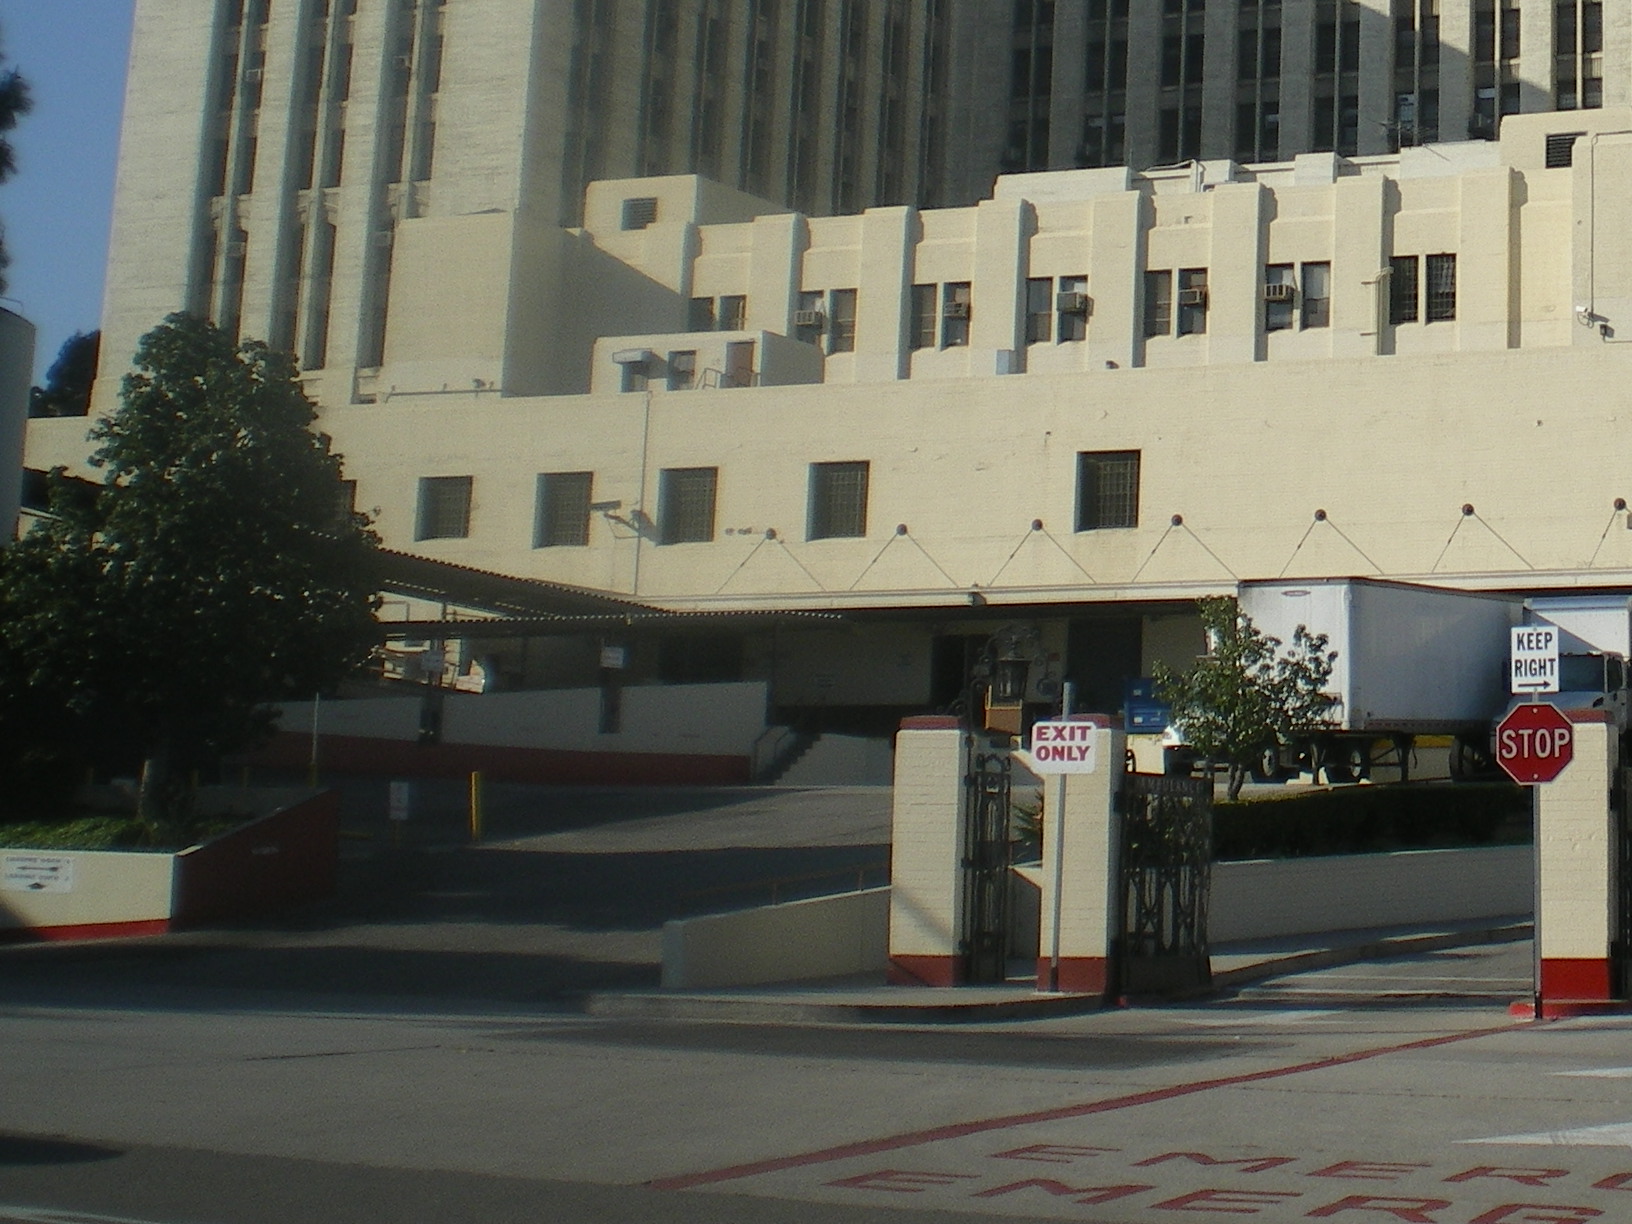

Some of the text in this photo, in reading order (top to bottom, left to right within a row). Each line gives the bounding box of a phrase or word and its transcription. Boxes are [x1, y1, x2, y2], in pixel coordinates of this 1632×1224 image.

[1516, 632, 1553, 651] KEEP
[1514, 658, 1556, 677] RIGHT
[1035, 725, 1092, 741] EXIT
[1501, 728, 1571, 759] STOP
[1035, 745, 1091, 762] ONLY
